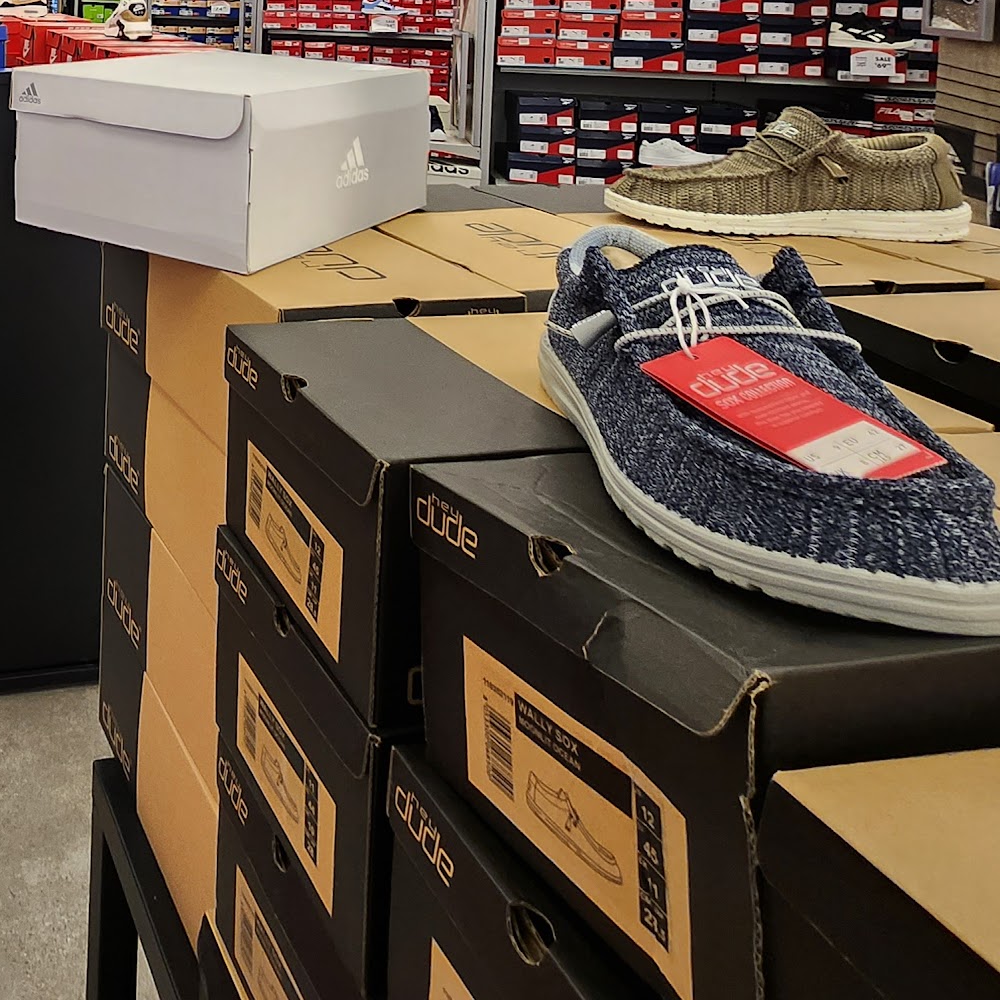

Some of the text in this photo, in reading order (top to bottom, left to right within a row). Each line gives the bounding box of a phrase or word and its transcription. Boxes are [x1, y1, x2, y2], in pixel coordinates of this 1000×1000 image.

[19, 95, 41, 104] adidas
[876, 107, 900, 115] FILA
[335, 167, 369, 189] adidas
[105, 303, 139, 355] dude
[227, 345, 258, 390] dude
[689, 362, 777, 399] dude
[715, 394, 743, 410] SOX
[109, 435, 139, 495] dude
[416, 494, 478, 560] dude
[431, 492, 459, 520] hey
[216, 548, 247, 605] dude
[107, 577, 140, 650] dude
[517, 697, 578, 758] WALLY SOX
[218, 756, 248, 827] dude
[395, 785, 454, 888] dude
[640, 802, 655, 831] 12
[647, 875, 659, 901] 11
